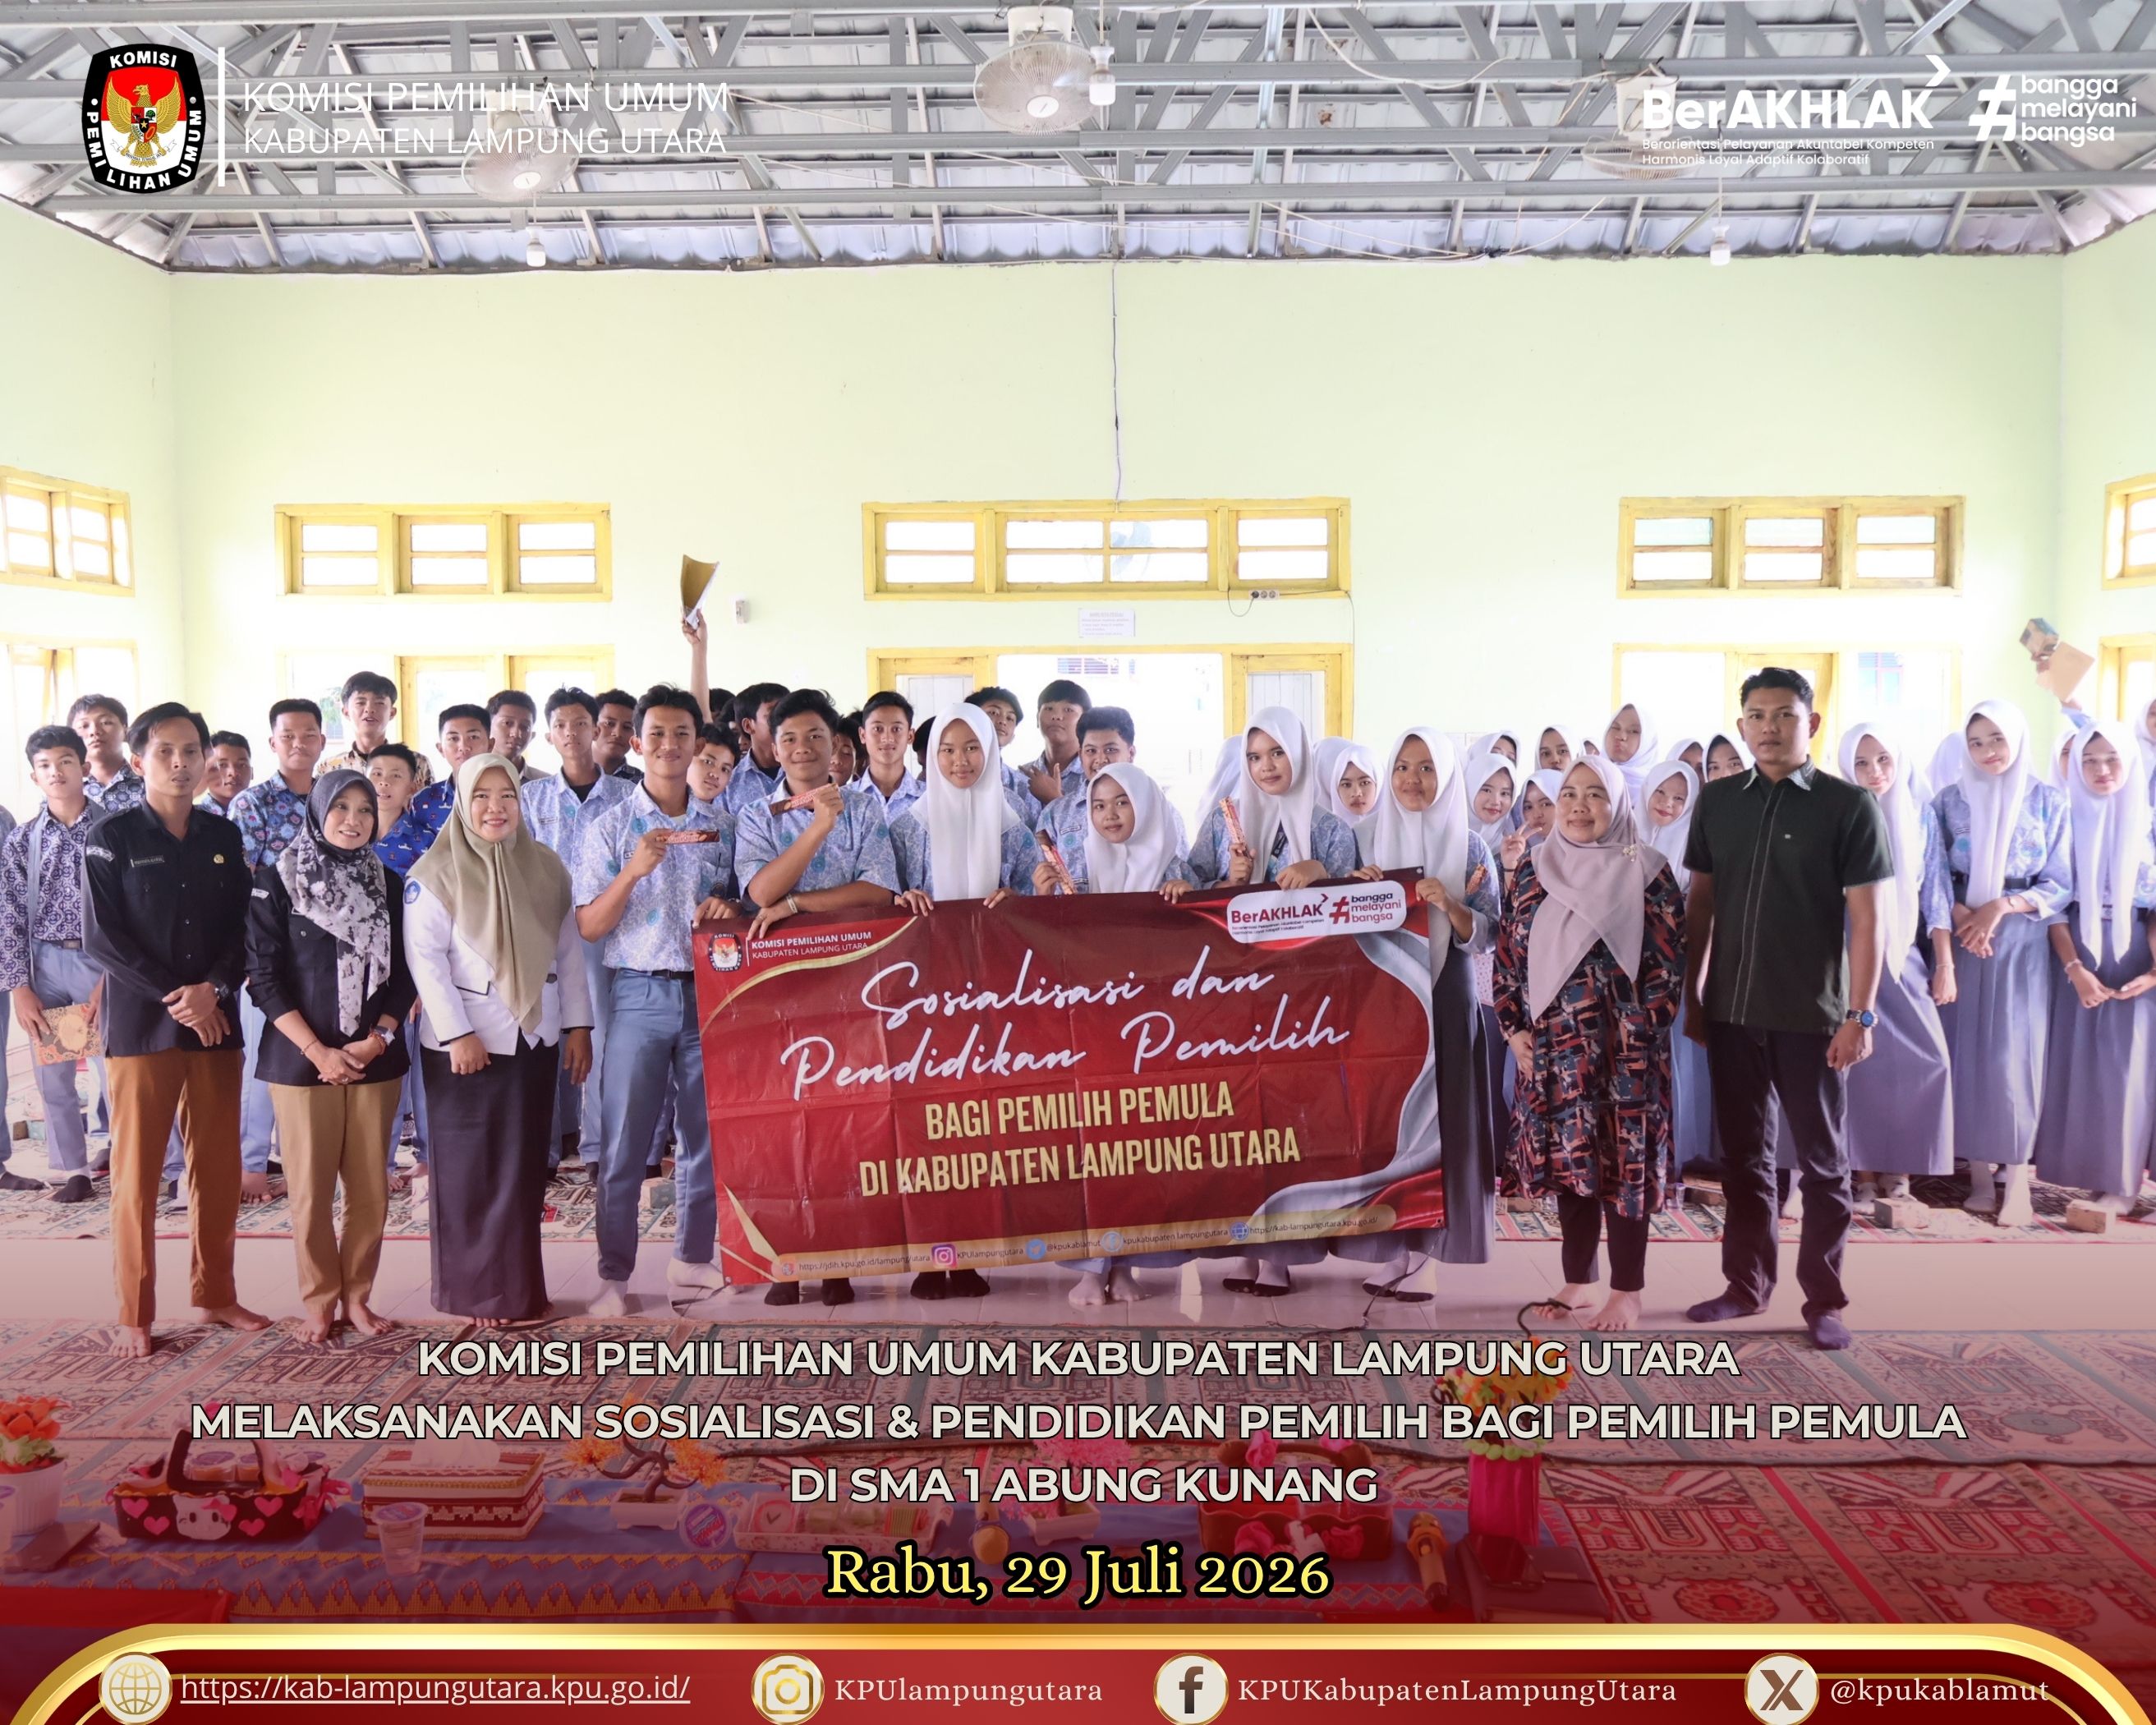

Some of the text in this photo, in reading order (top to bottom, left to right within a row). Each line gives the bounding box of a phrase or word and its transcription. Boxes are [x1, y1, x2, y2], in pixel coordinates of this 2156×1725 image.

[1351, 892, 1394, 904] bangga
[1351, 899, 1402, 913] melayani
[1231, 904, 1324, 924] BerAKHLAK
[1351, 912, 1393, 925] bangsa
[751, 932, 872, 950] KOMISI PEMILIHAN UMUM
[752, 941, 868, 959] KABUPATEN LAMPUNG UTARA
[861, 944, 1275, 1031] Sosialisasi dan
[779, 992, 1350, 1102] Pendidikan Pemilih
[925, 1080, 1234, 1141] BAGI PEMILIH PEMULA
[859, 1126, 1301, 1197] DI KABUPATEN LAMPUNG UTARA
[1123, 1228, 1229, 1245] kpukabupaten lampungutara
